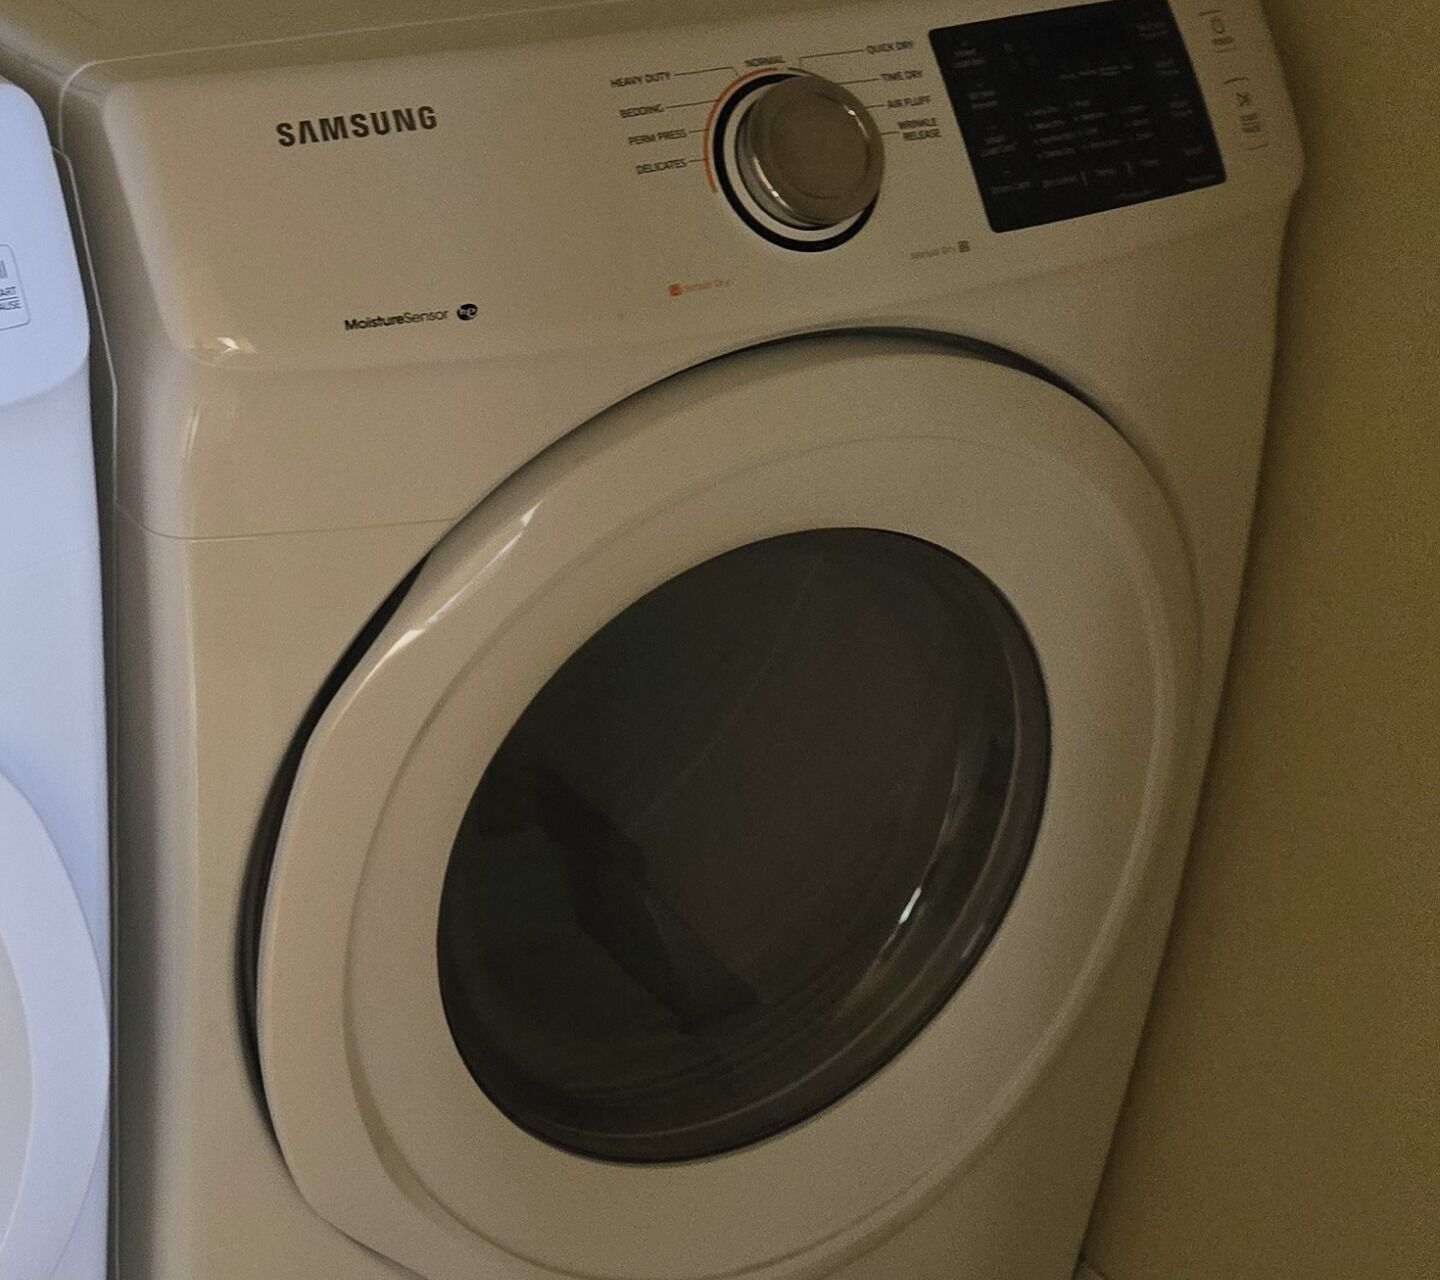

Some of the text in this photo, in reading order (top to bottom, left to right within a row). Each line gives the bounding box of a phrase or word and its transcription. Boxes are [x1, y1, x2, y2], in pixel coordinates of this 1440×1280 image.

[610, 72, 671, 88] HEAVY DUTY
[276, 105, 437, 147] SAMSUNG
[657, 128, 687, 141] PRESS
[636, 158, 687, 175] DELICATES
[344, 309, 449, 331] MoistureSensor
